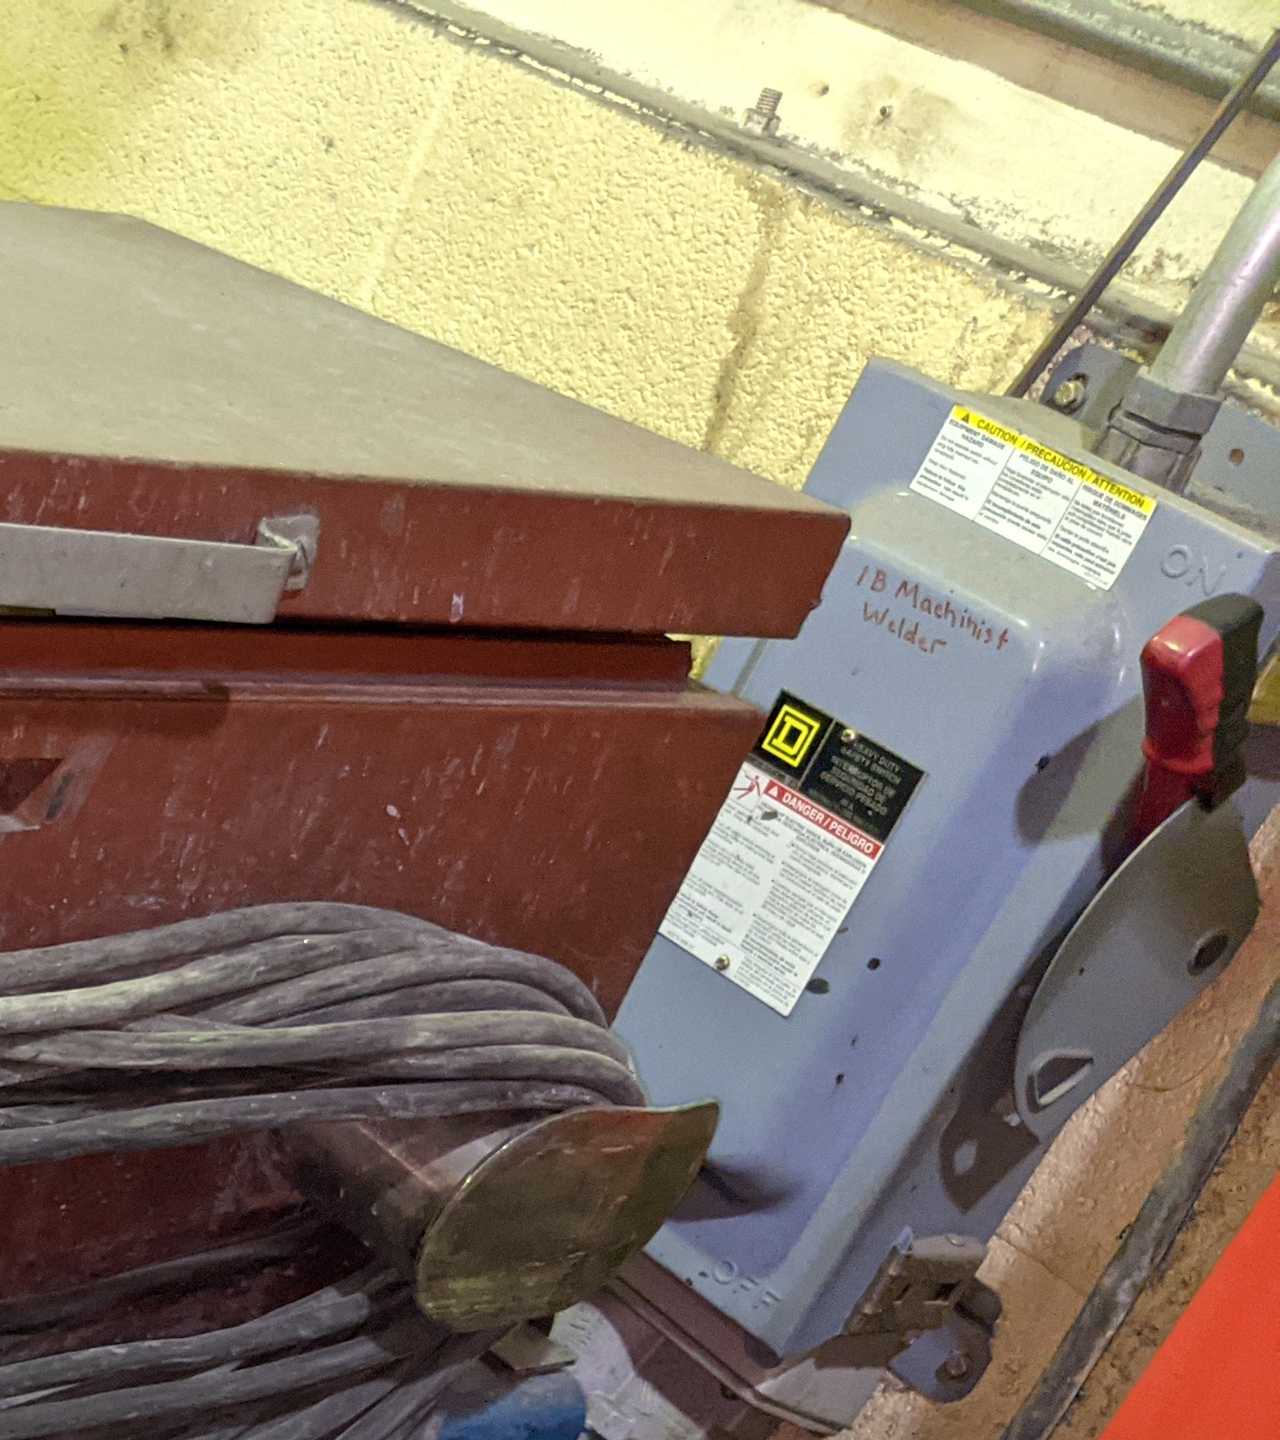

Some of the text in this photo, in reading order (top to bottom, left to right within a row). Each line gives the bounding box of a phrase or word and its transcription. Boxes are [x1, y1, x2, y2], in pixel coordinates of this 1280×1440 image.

[976, 418, 1018, 445] CAUTION
[1091, 475, 1145, 508] ATTENTION
[780, 793, 825, 825] DANGER
[827, 820, 874, 854] PELIGRO
